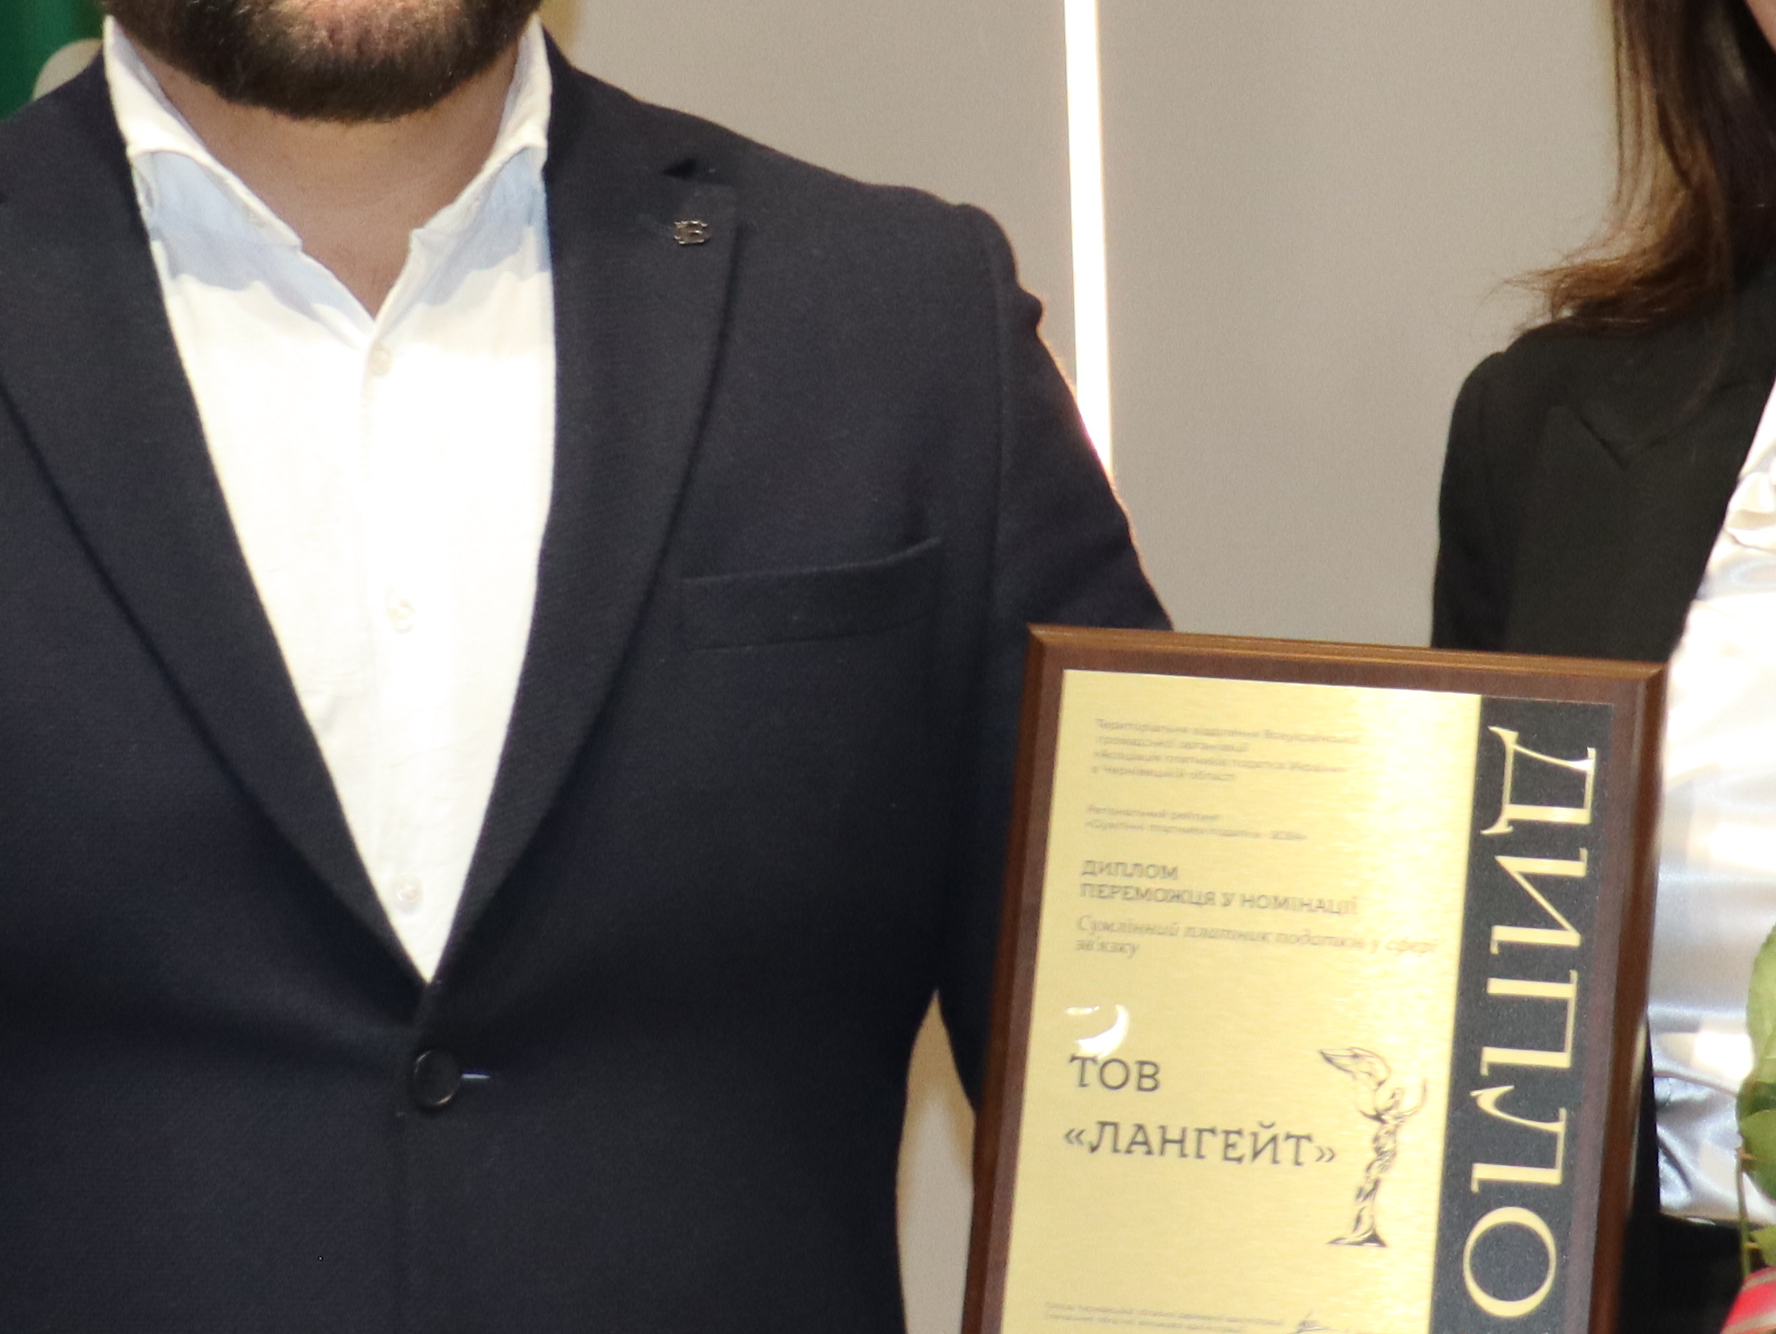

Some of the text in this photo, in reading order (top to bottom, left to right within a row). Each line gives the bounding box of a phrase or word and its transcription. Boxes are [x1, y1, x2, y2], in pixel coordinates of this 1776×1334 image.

[1081, 860, 1179, 881] ДИПЛОМ
[1080, 882, 1216, 907] ПЕРЕМОЖЦЯ
[1069, 1053, 1161, 1093] ТОВ
[1064, 1120, 1337, 1167] «ЛАНГЕЙТ»
